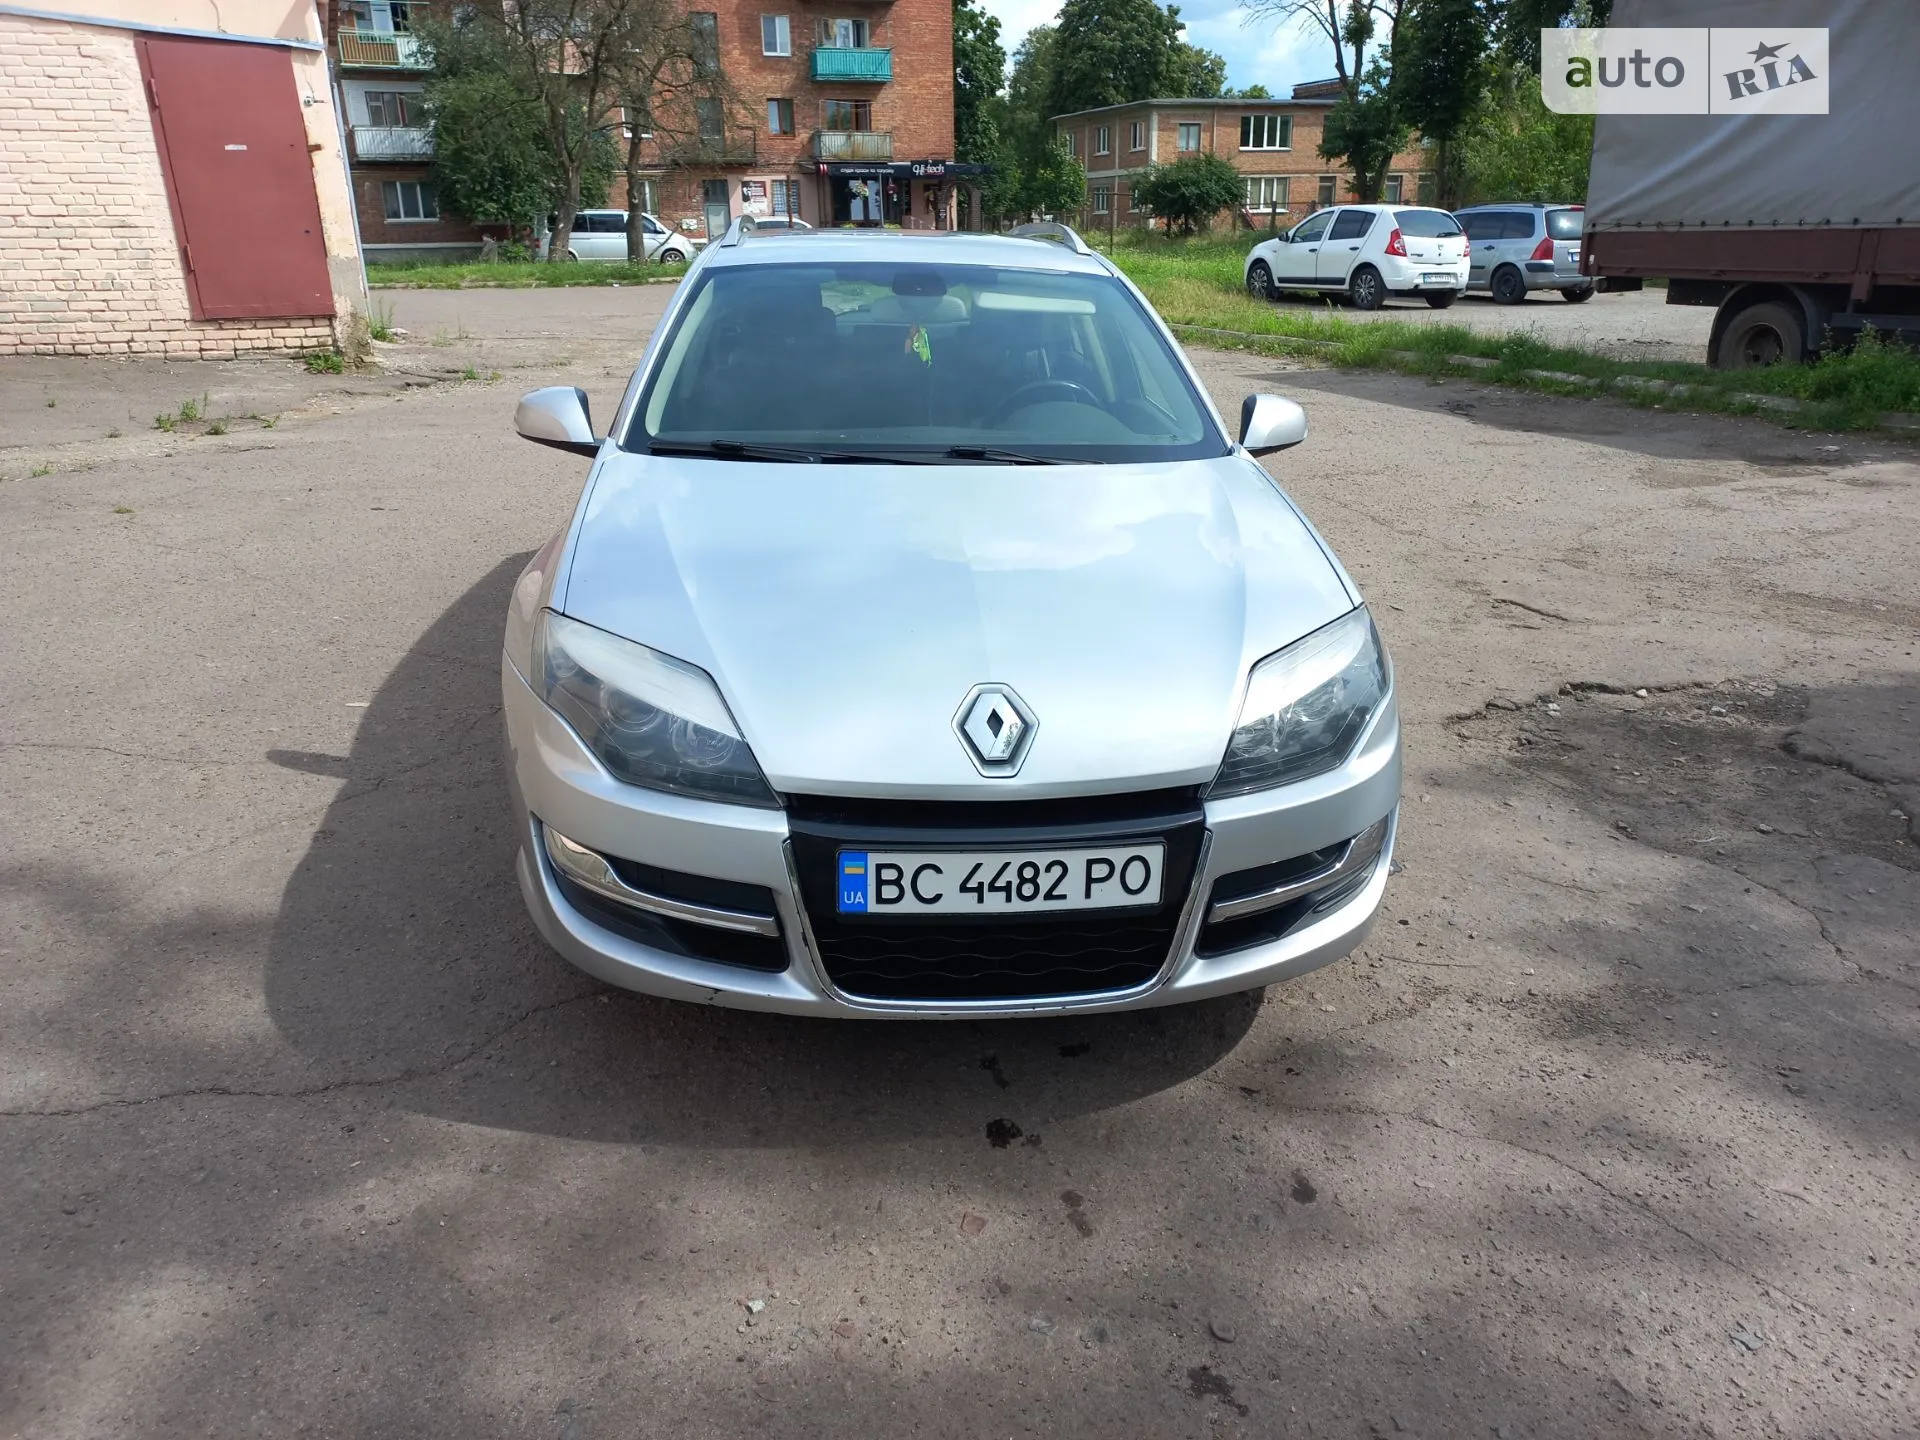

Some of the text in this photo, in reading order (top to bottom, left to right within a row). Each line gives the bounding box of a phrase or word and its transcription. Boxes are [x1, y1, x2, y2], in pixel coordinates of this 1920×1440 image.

[875, 854, 1151, 905] BC 4482 PO
[844, 892, 864, 905] UA
